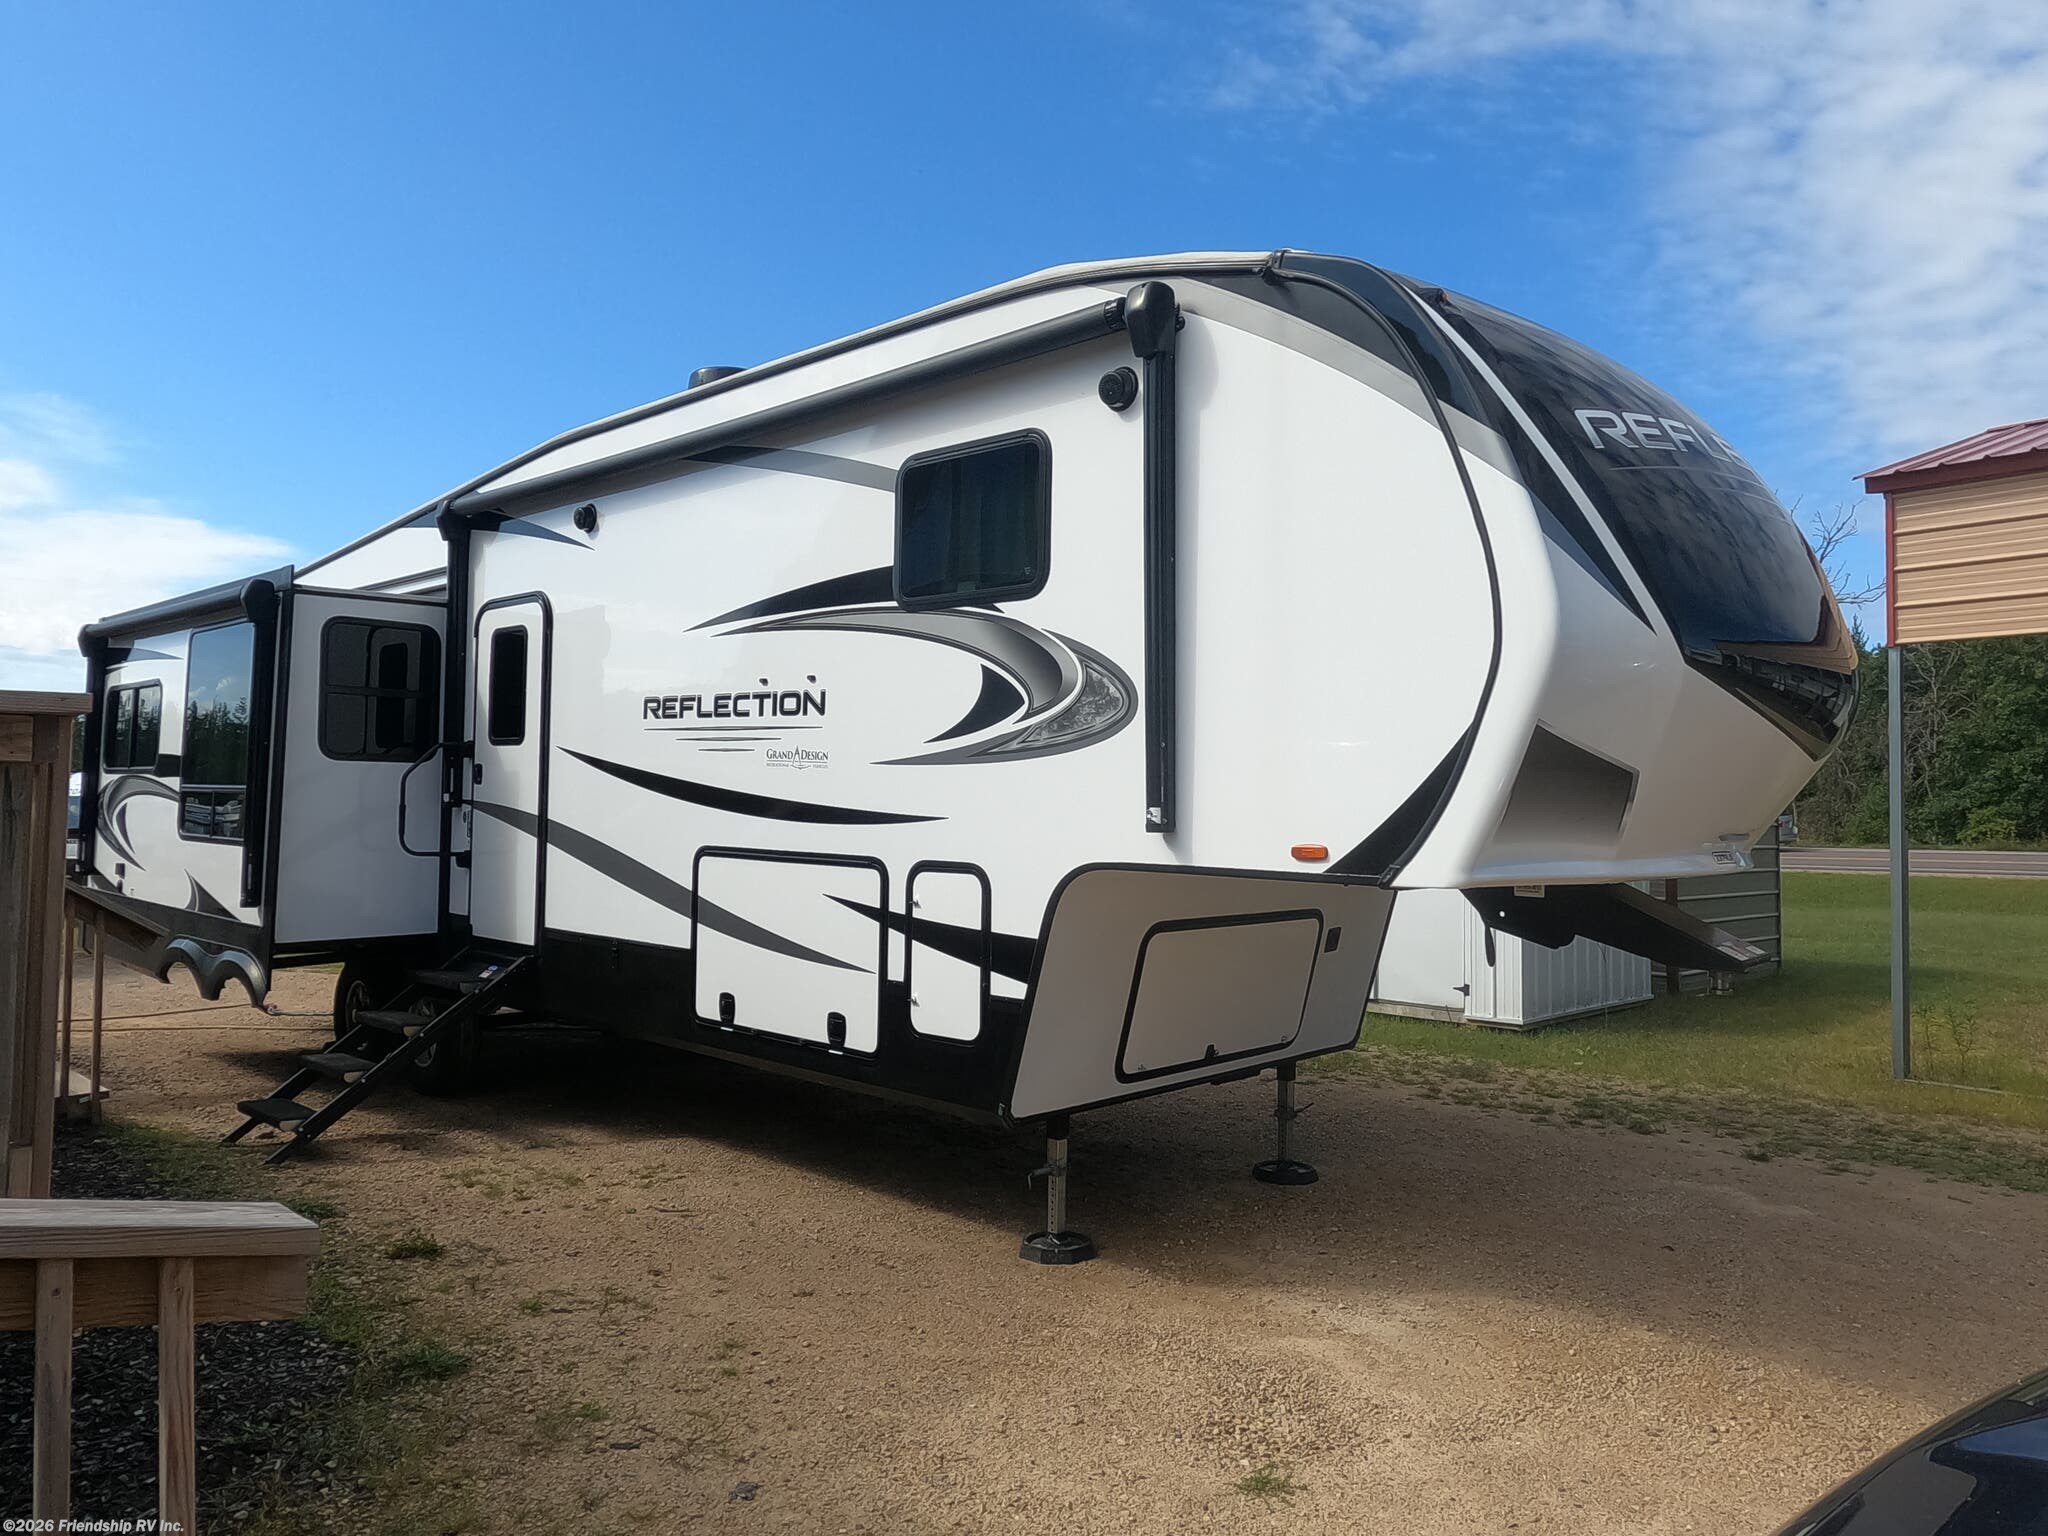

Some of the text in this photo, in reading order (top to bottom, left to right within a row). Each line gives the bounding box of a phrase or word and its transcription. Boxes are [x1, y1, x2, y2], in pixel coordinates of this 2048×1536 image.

[1574, 409, 1756, 472] REFLE
[643, 688, 827, 720] REFLECTION
[766, 748, 829, 761] GRAND DESIGN
